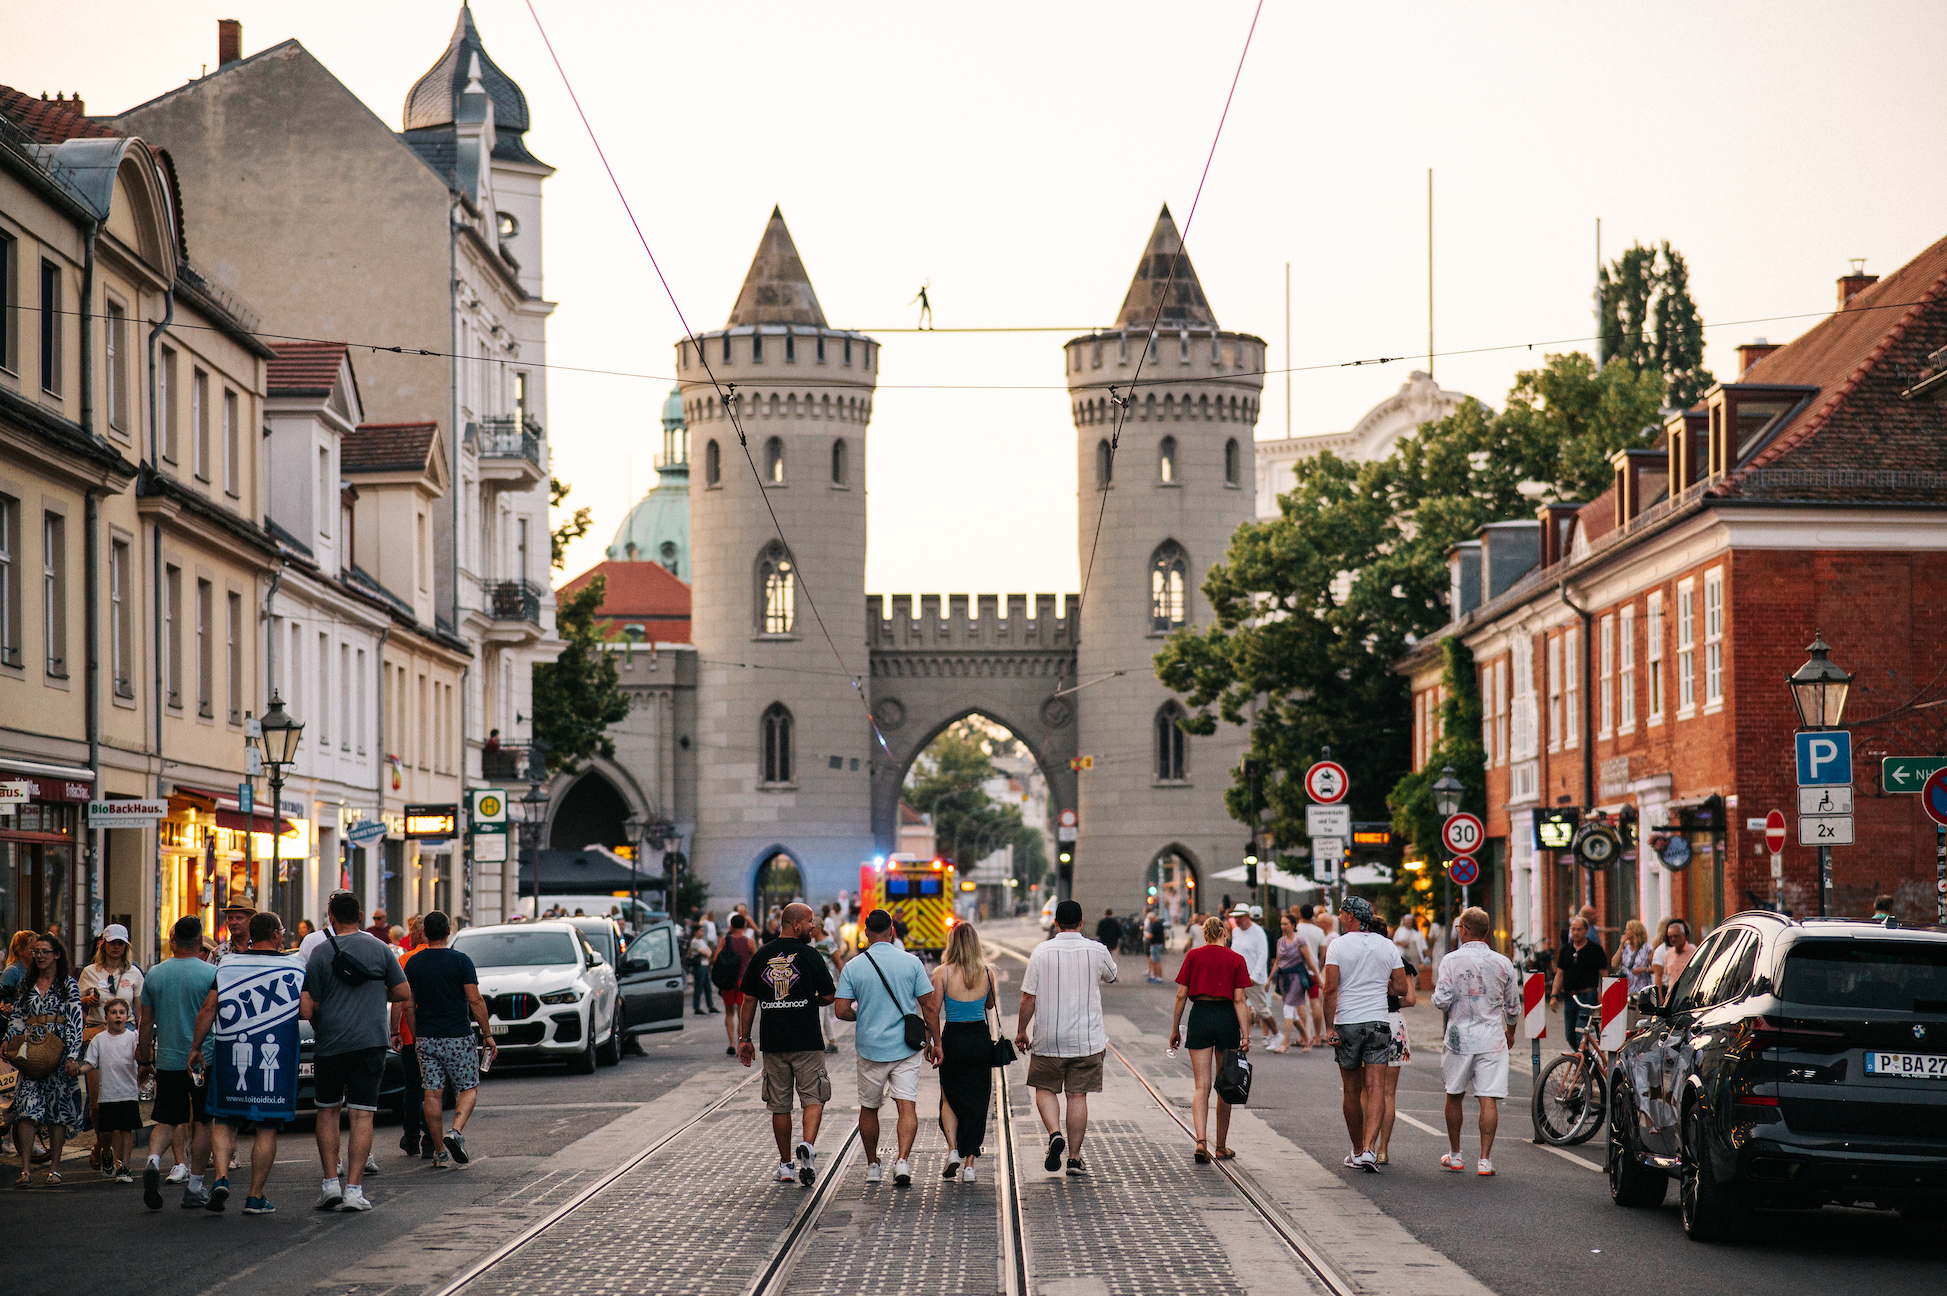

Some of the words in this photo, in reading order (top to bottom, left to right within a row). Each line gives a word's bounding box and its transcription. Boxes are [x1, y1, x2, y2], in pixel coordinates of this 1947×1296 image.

[1809, 739, 1838, 779] P
[91, 803, 163, 814] BioBackHaus.
[1452, 825, 1475, 843] 30
[1818, 824, 1835, 838] 2x
[1880, 1055, 1891, 1071] P
[1902, 1056, 1925, 1073] BA
[226, 1095, 286, 1105] www.toitoidixi.de
